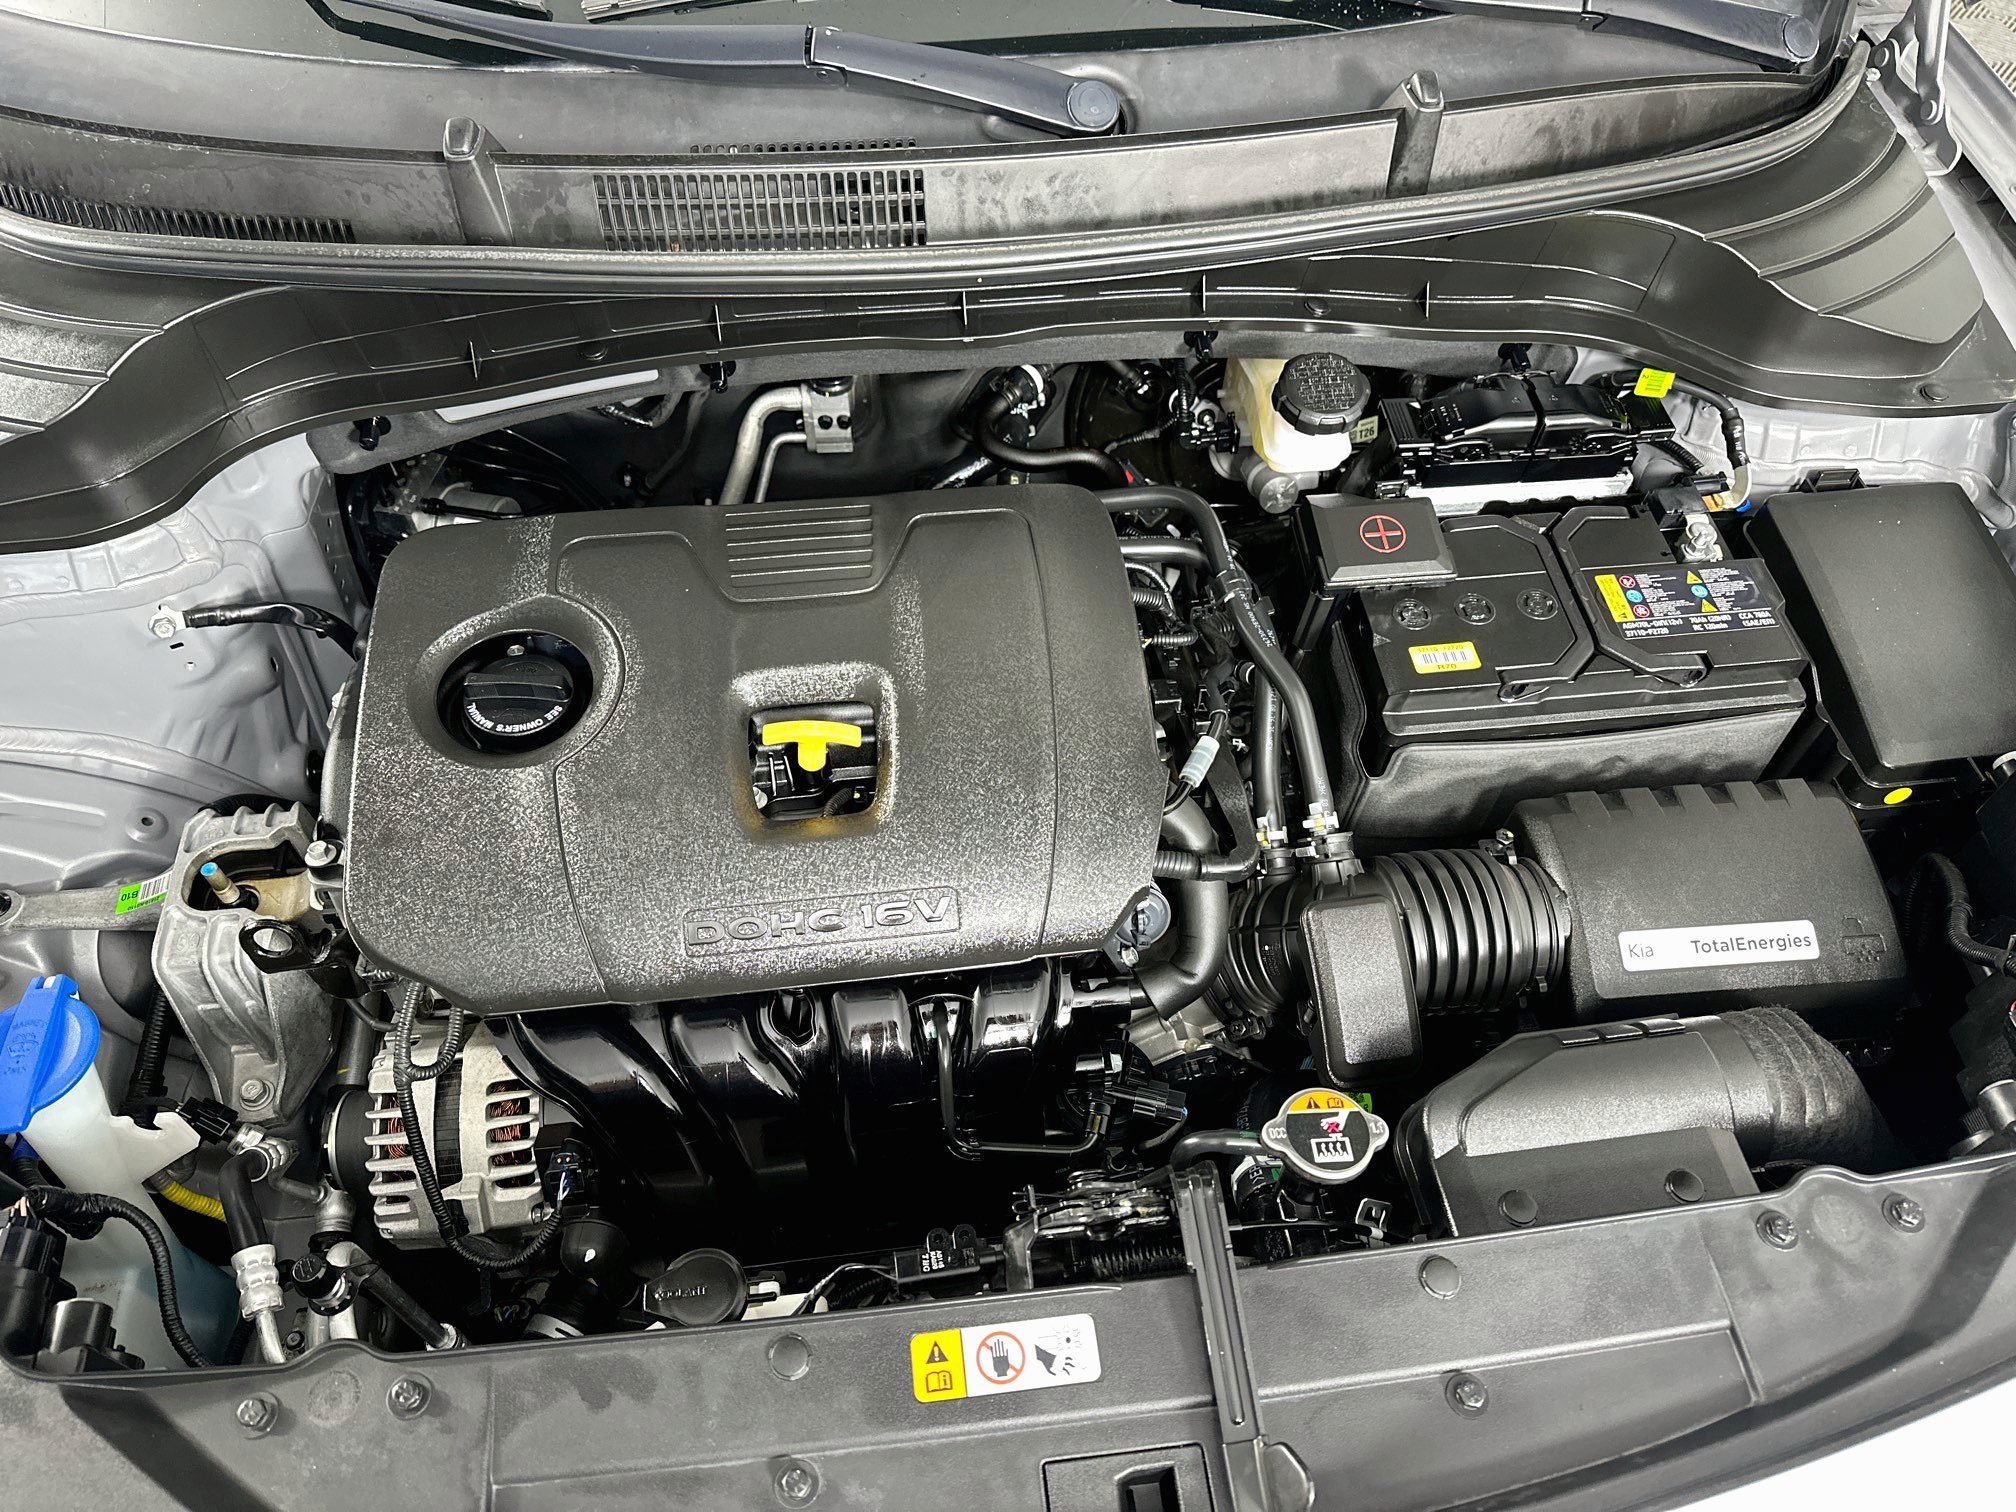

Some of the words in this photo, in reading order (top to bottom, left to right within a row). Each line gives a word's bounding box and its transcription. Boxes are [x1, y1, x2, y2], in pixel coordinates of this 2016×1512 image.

[1359, 426, 1375, 439] T26
[1738, 612, 1754, 620] CCA
[1693, 623, 1703, 631] RC
[466, 702, 495, 729] MANUAL
[543, 705, 563, 721] SEE
[495, 718, 544, 733] OWNER'S
[687, 907, 846, 945] DOHC
[860, 895, 951, 928] 16V
[1628, 943, 1655, 958] Kia
[1690, 933, 1812, 955] TotalEnergies
[1268, 1127, 1288, 1139] DCC
